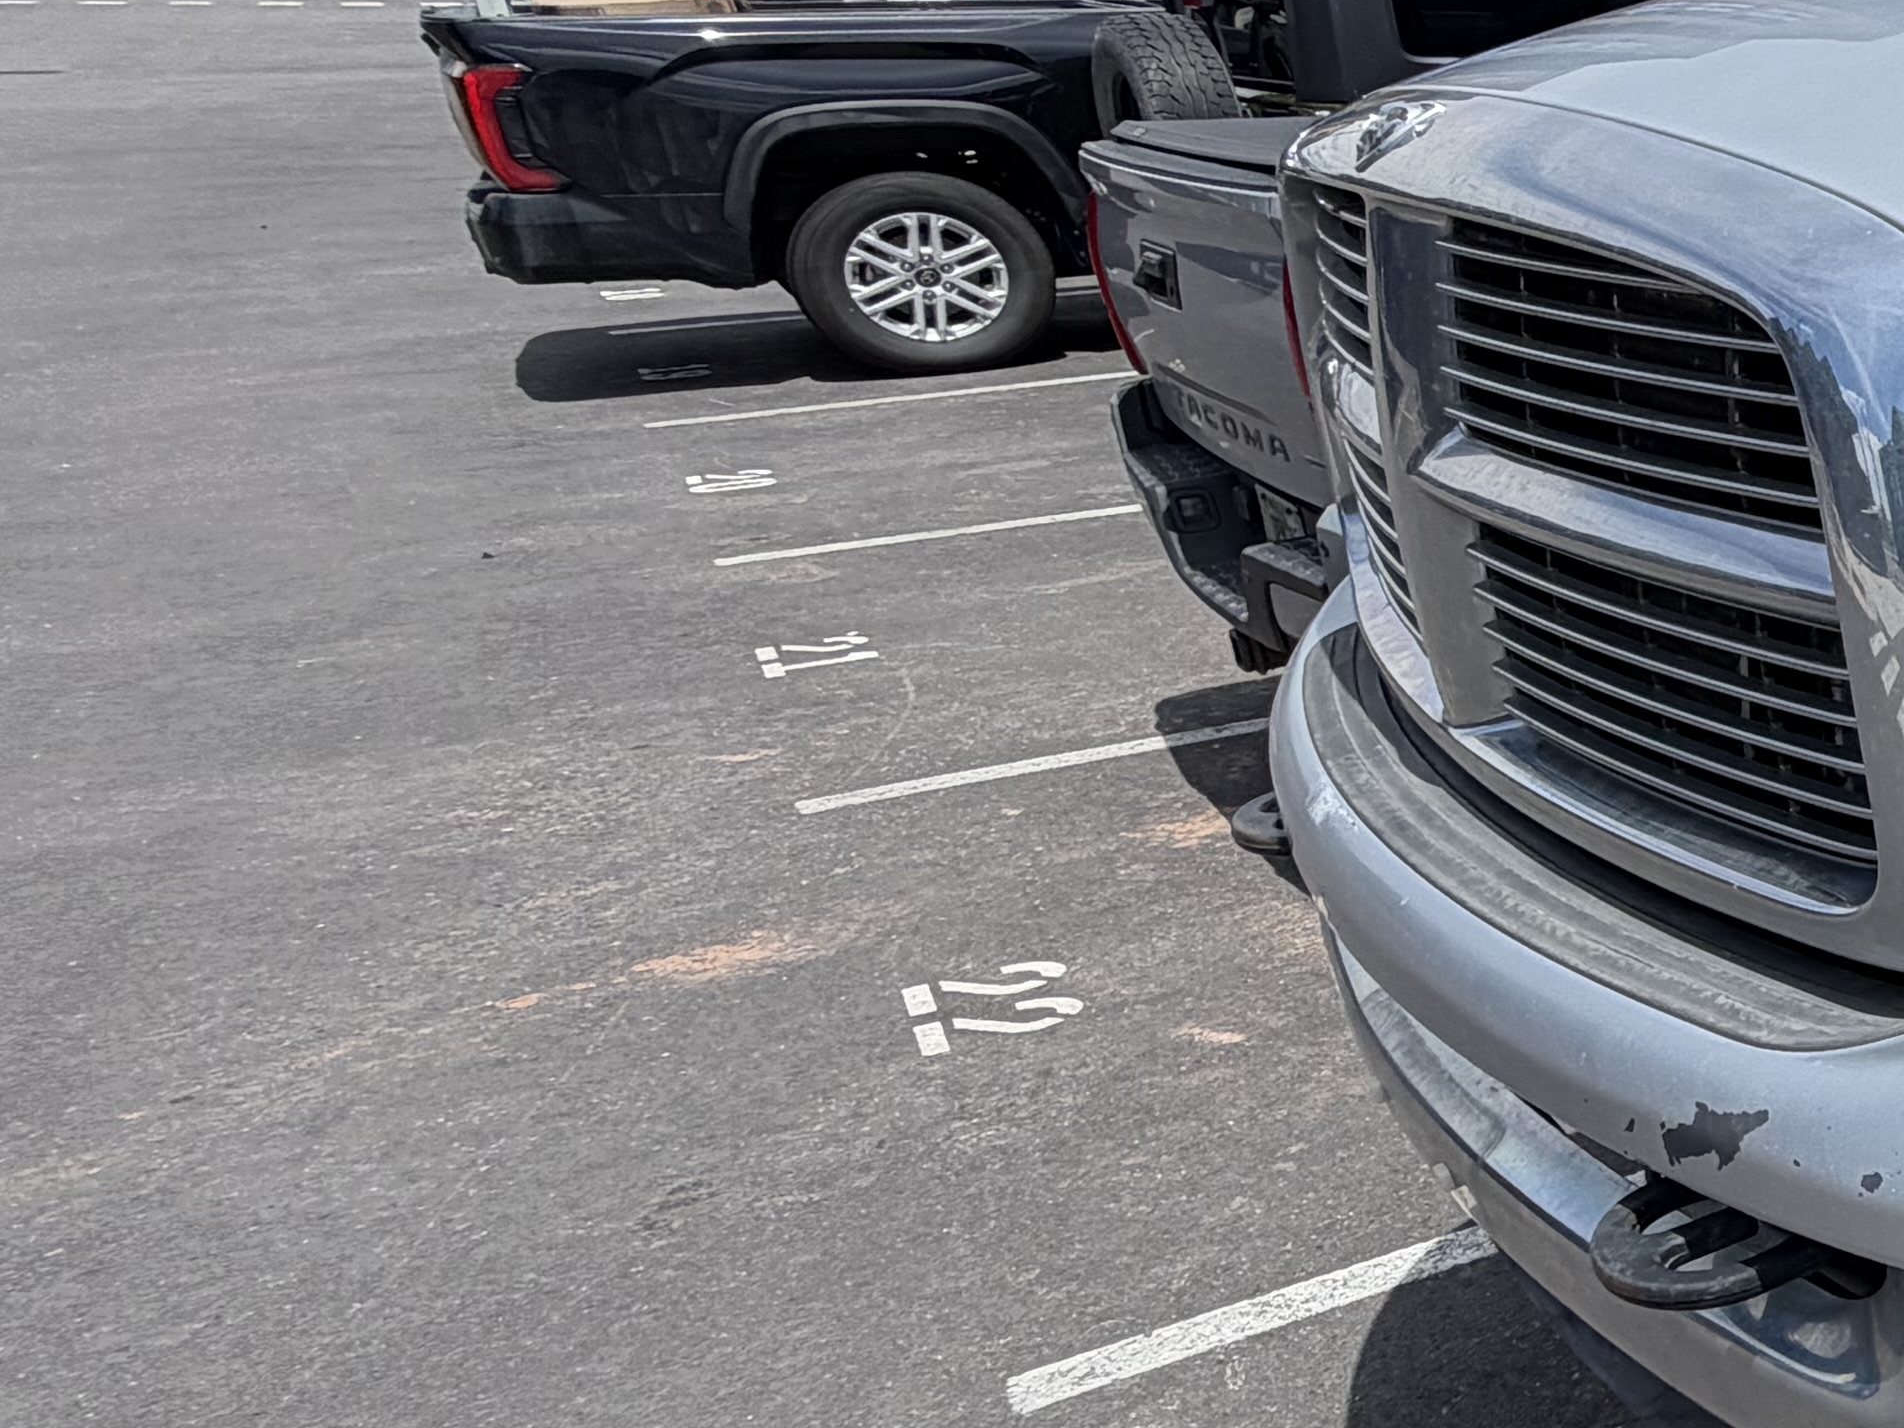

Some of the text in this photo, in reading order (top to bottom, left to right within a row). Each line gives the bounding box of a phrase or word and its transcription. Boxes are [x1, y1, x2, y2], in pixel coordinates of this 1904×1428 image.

[1173, 385, 1291, 463] TACOMA
[685, 468, 778, 494] 20
[753, 630, 880, 679] 21
[900, 959, 1085, 1058] 22
